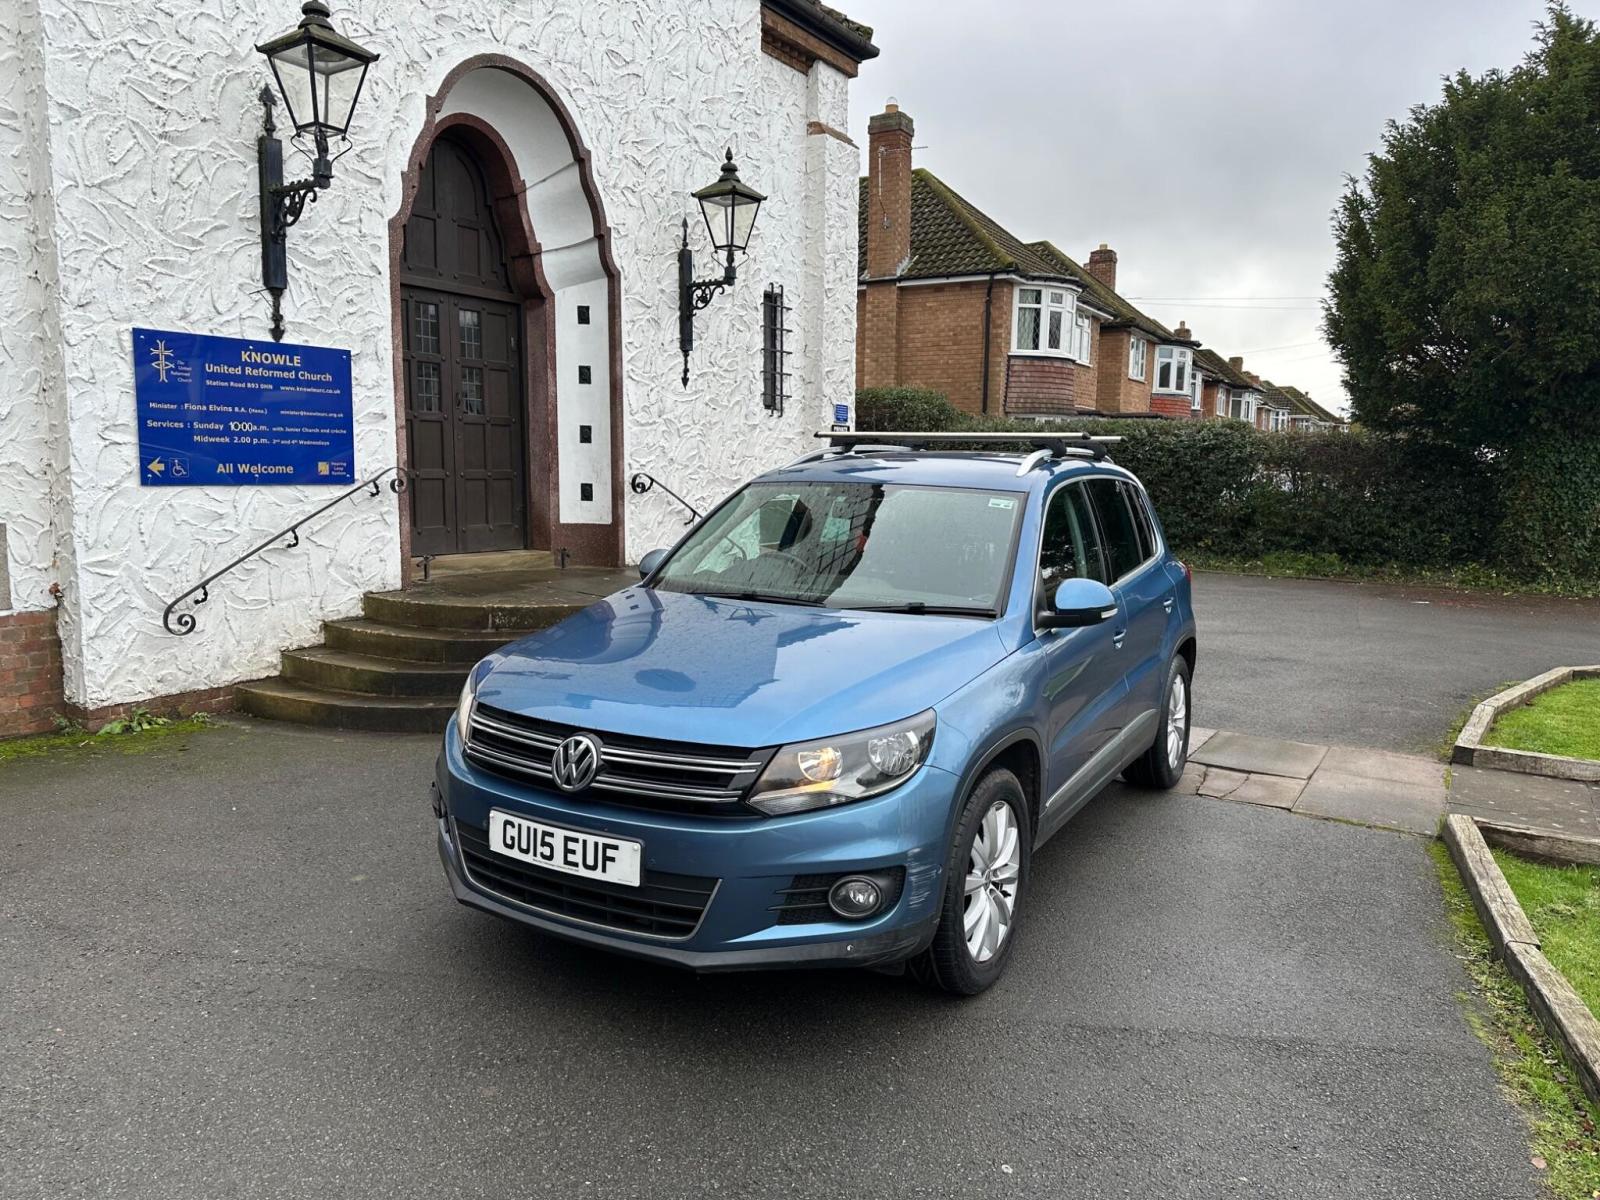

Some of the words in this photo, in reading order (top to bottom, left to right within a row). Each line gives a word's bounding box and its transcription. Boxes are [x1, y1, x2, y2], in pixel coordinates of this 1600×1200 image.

[241, 351, 301, 366] KNOWLE
[205, 363, 242, 375] United
[245, 366, 295, 379] Reformed
[298, 371, 332, 382] Church
[205, 379, 229, 387] Station
[230, 380, 246, 388] Road
[149, 402, 177, 410] Minister
[184, 403, 207, 411] Fiona
[209, 404, 233, 412] Elvins
[146, 420, 184, 429] Services
[193, 422, 224, 431] Sunday
[193, 435, 230, 443] Midweek
[233, 436, 251, 444] 2.00
[253, 437, 270, 445] p.m.
[216, 463, 233, 474] All
[237, 463, 294, 474] Welcome
[502, 819, 555, 862] GU15
[563, 835, 619, 874] EUF
